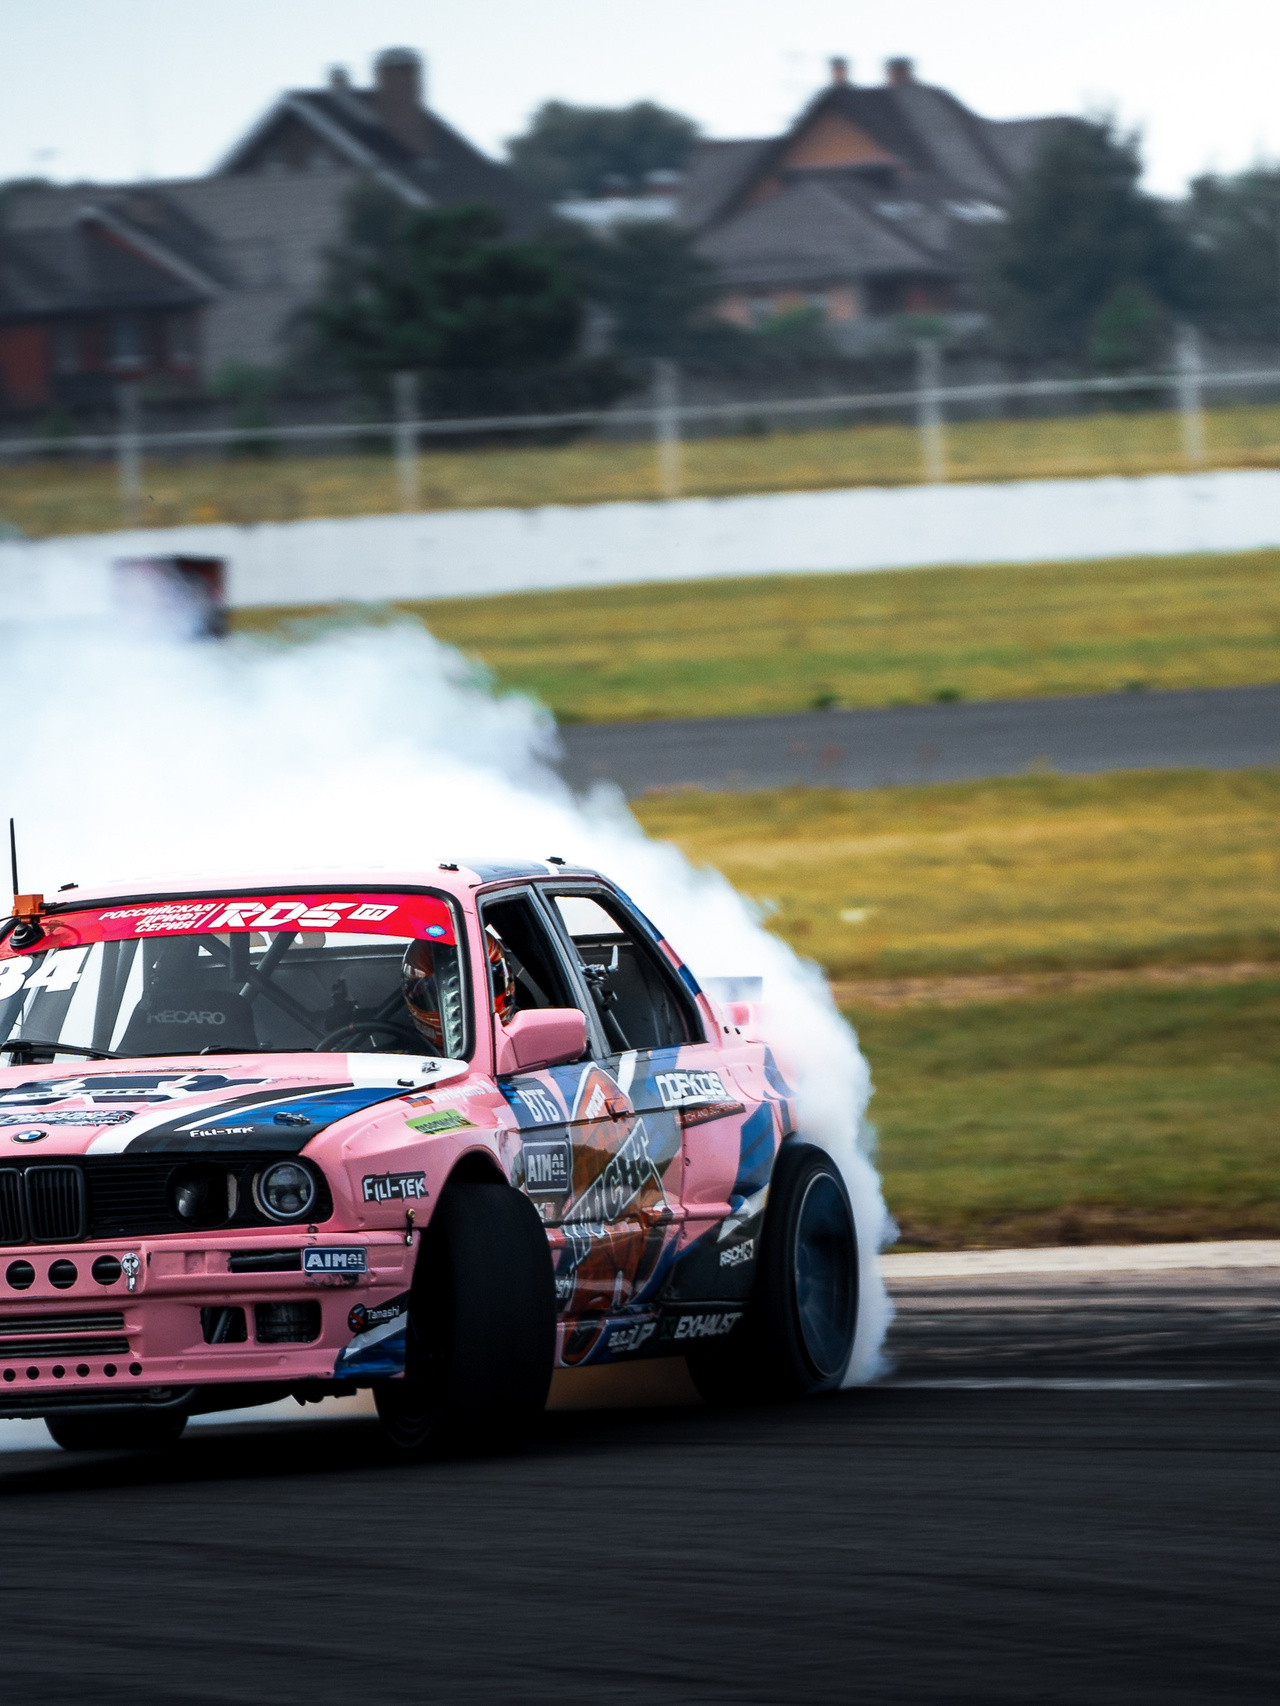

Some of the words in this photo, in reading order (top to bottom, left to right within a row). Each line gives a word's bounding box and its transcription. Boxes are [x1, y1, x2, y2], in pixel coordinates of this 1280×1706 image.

[98, 903, 216, 920] РОССИЙСКАЯ
[135, 912, 206, 925] ДРИФТ
[207, 902, 358, 928] RDS
[134, 921, 196, 933] СЕРИЯ
[517, 1089, 561, 1122] ВТБ
[527, 1153, 567, 1182] AIMOL
[306, 1253, 365, 1268] AIMOL
[366, 1305, 400, 1320] Tamashi
[674, 1312, 744, 1339] EXHAUST
